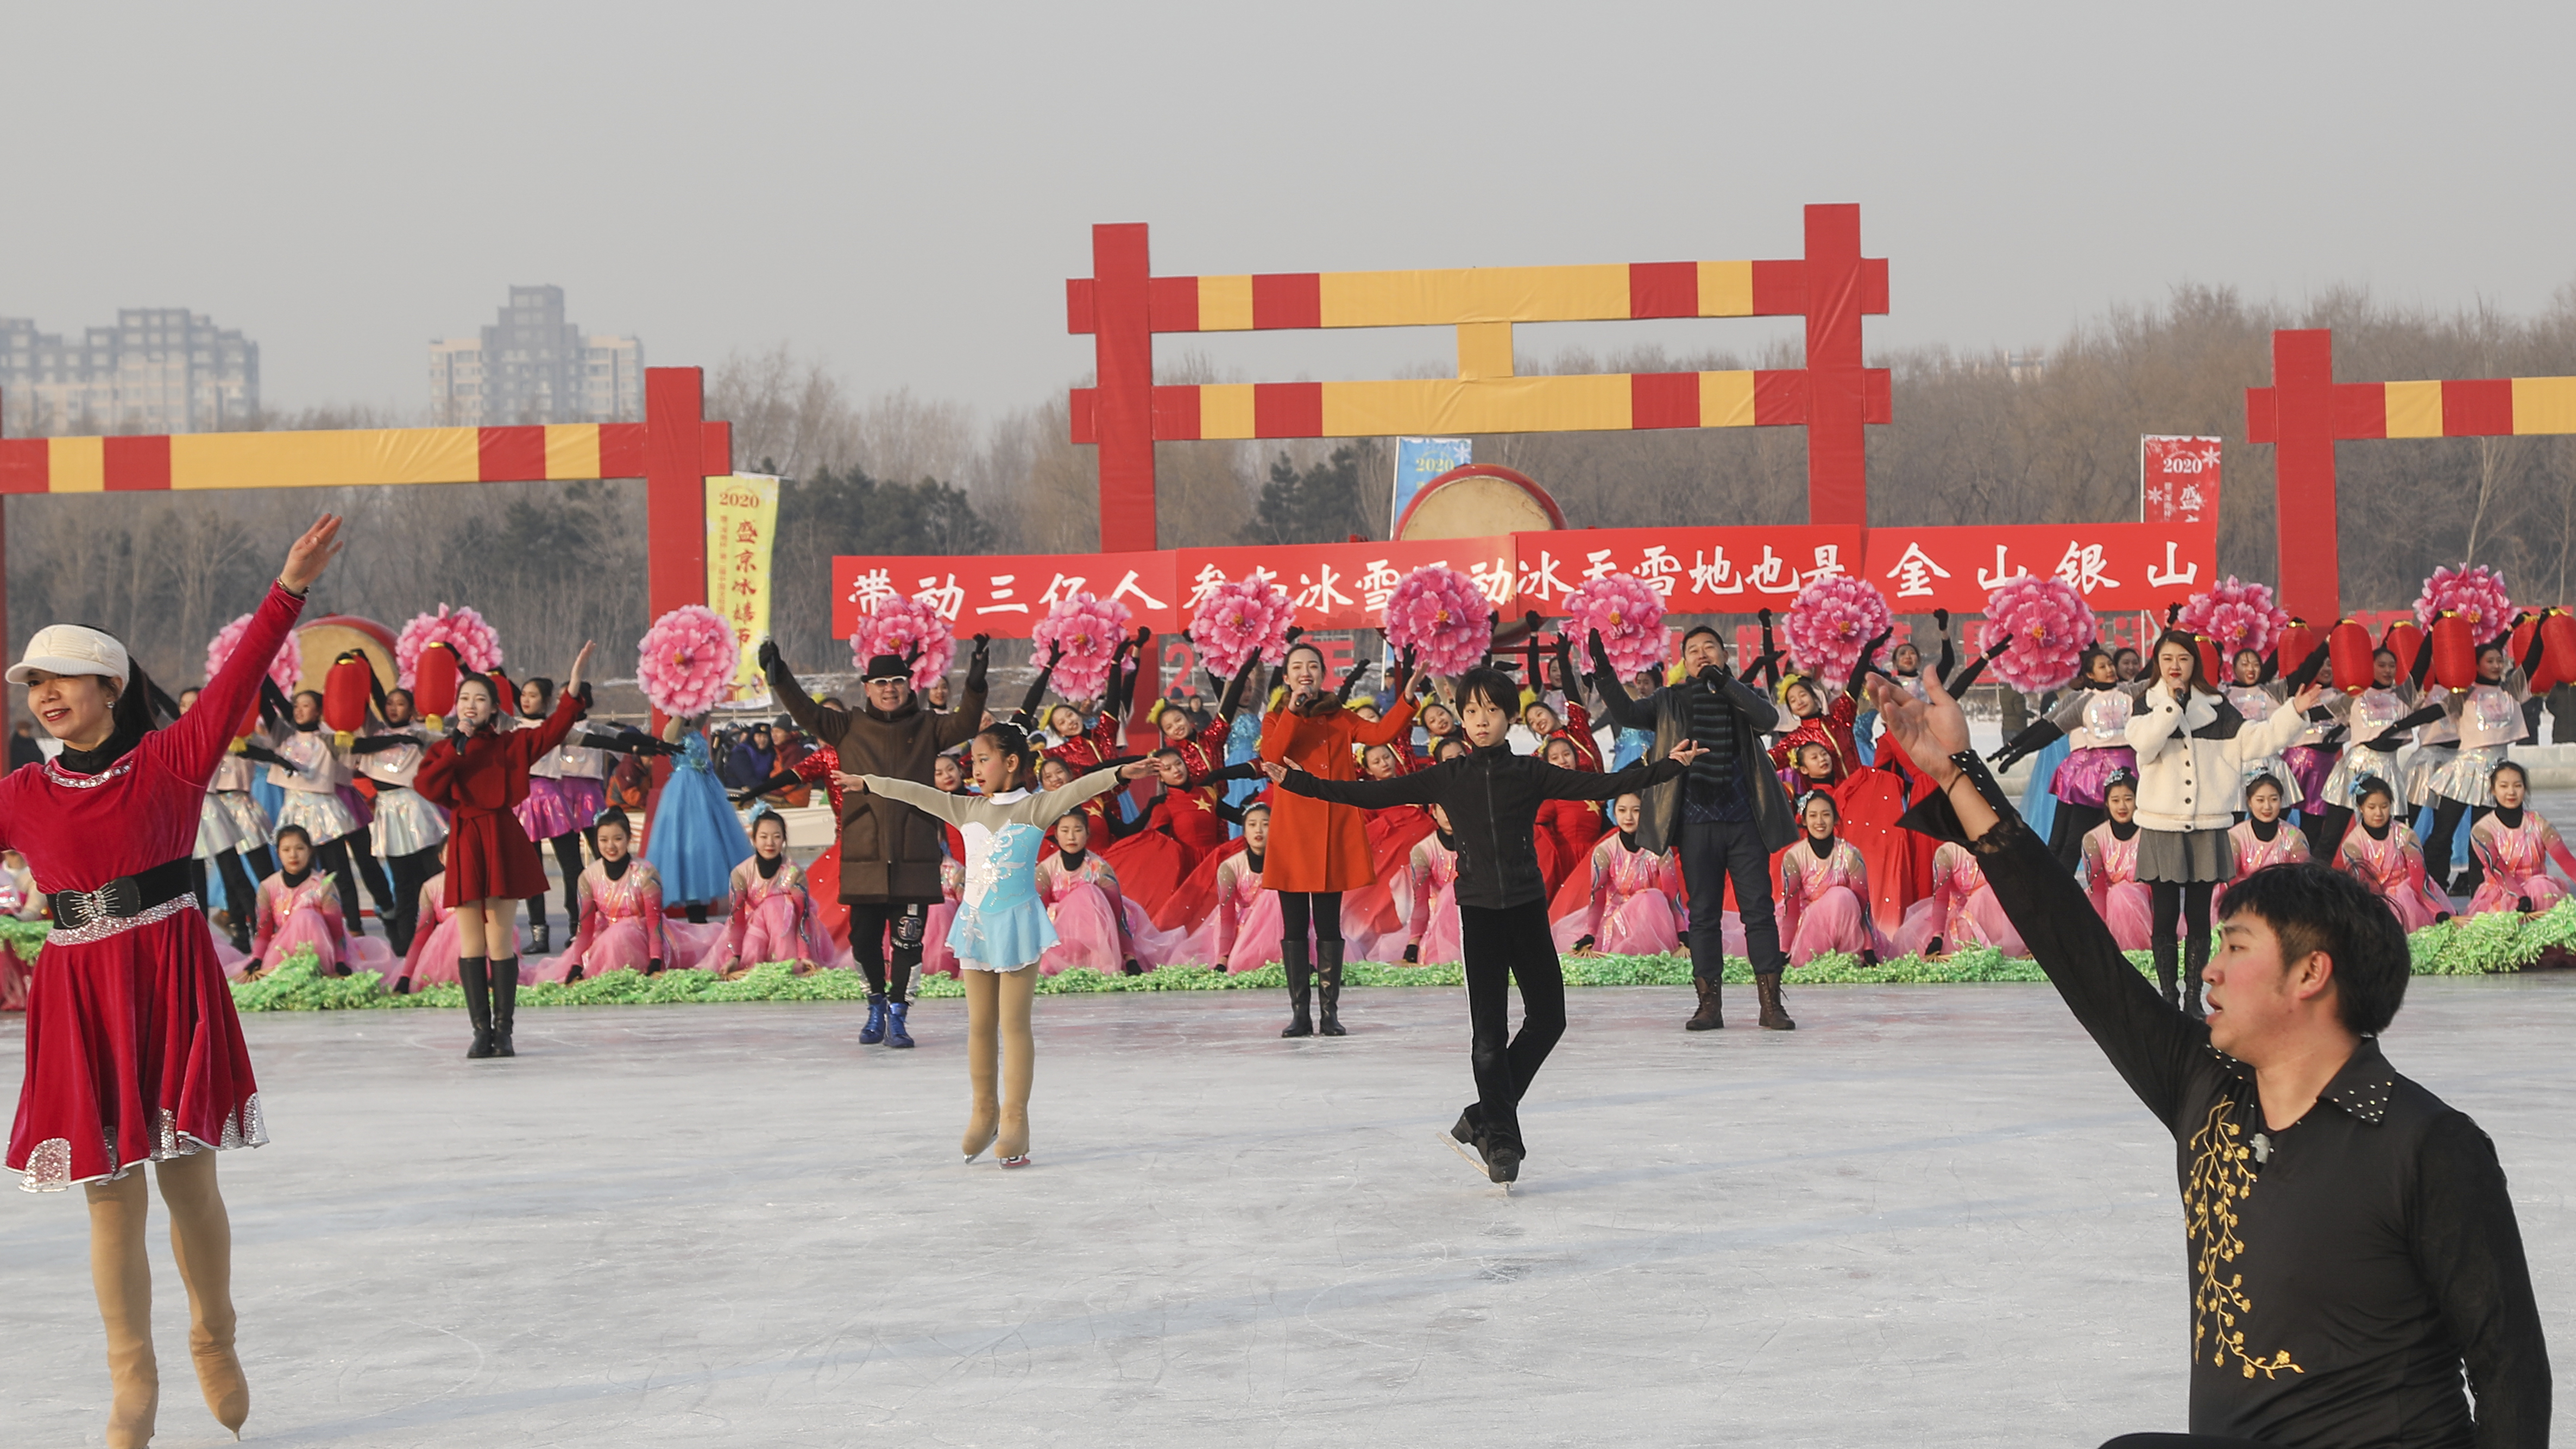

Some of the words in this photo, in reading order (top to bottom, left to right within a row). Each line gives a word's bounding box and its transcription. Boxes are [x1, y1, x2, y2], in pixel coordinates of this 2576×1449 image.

[1415, 458, 1454, 472] 2020
[2163, 458, 2203, 474] 2020
[719, 492, 759, 508] 2020
